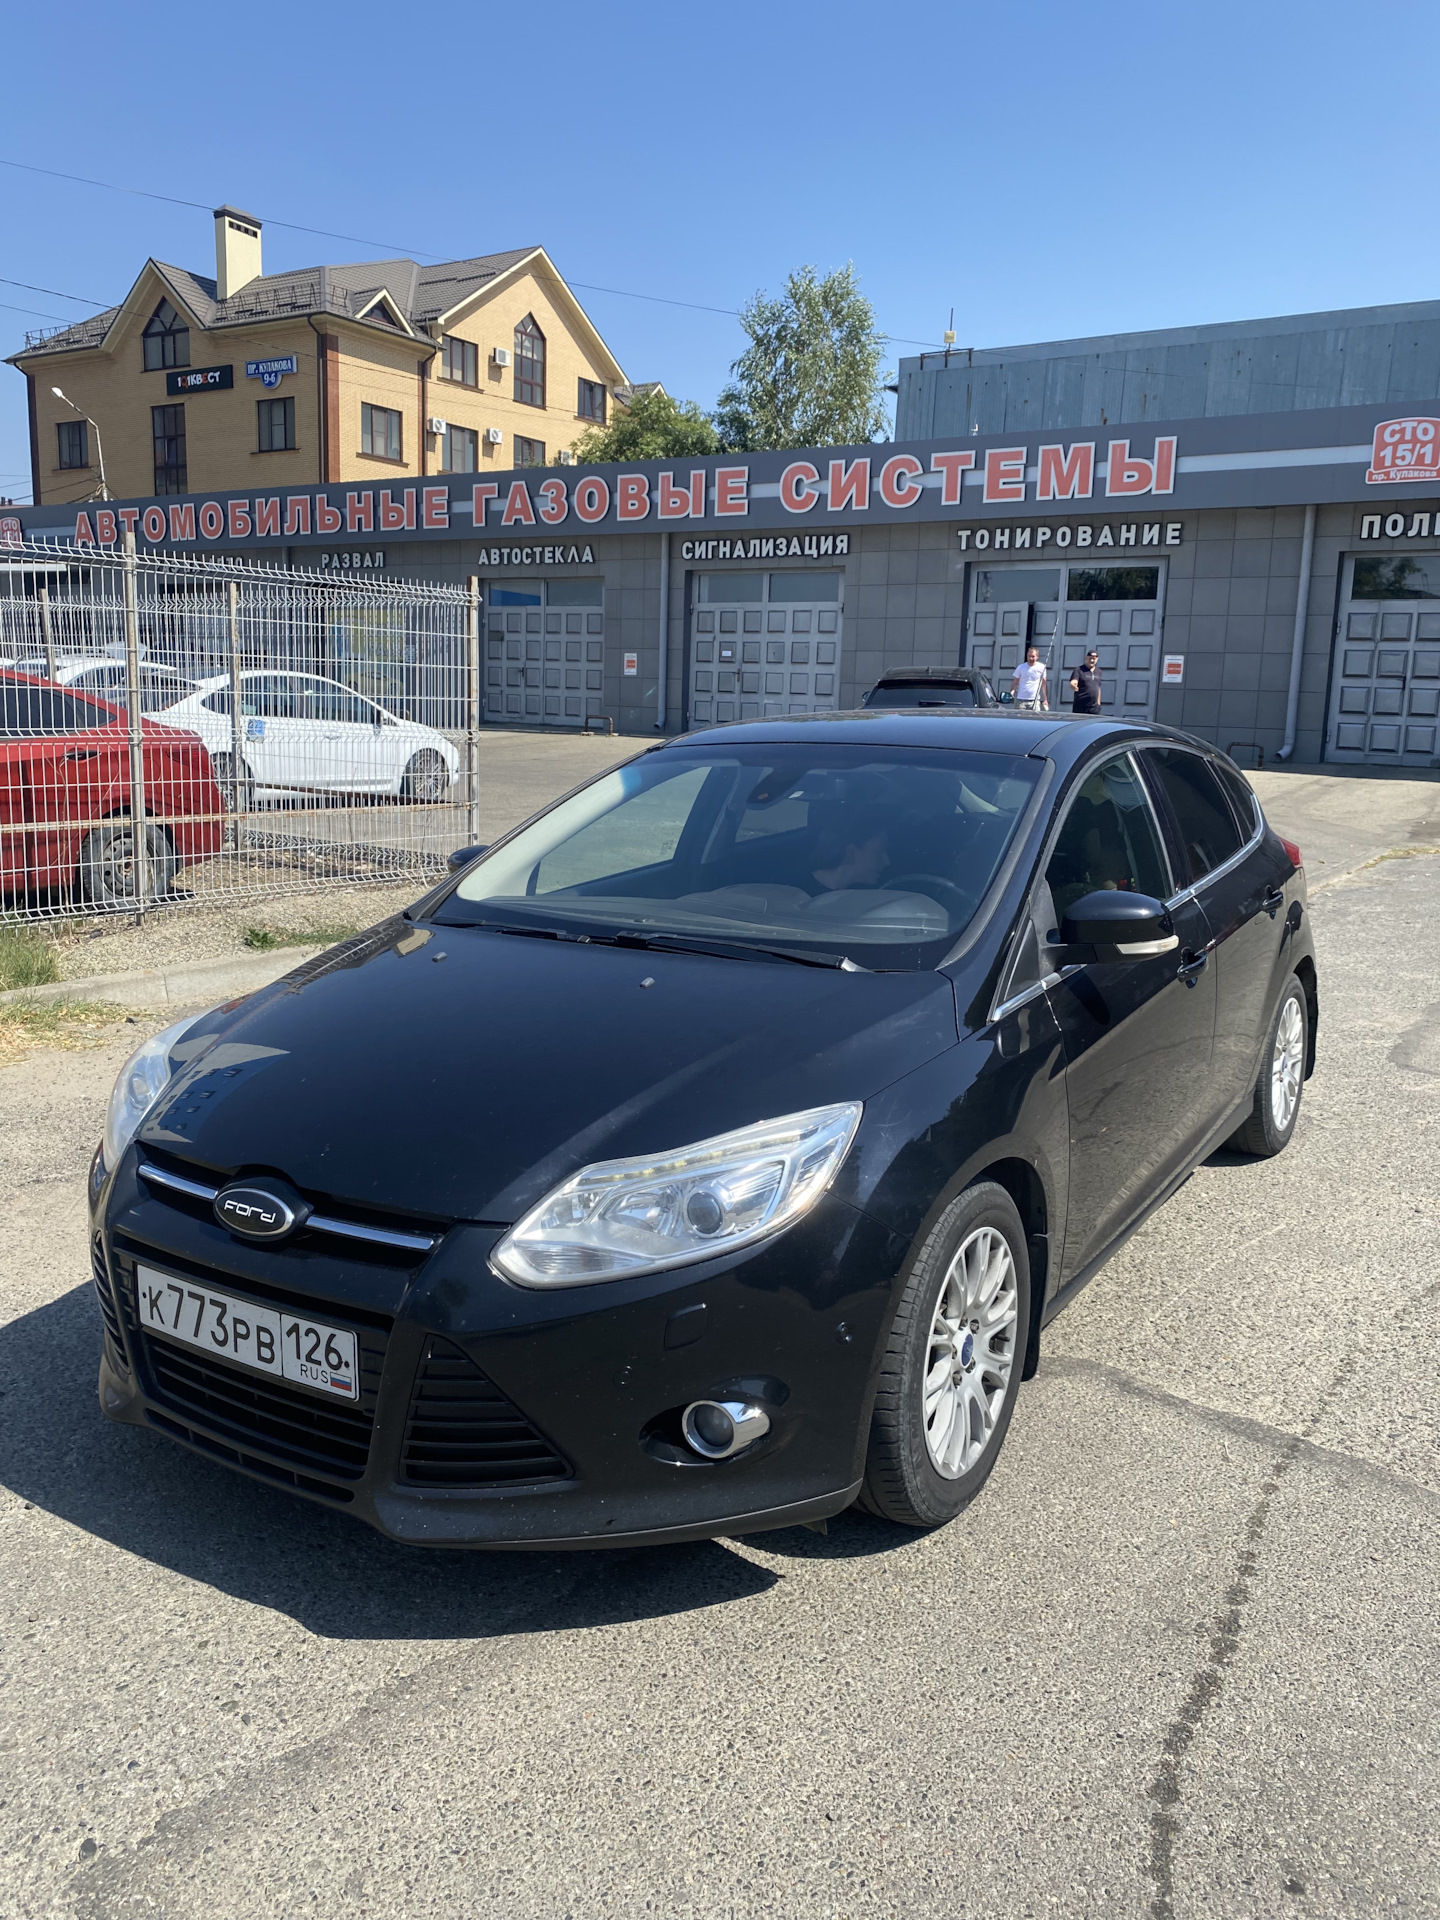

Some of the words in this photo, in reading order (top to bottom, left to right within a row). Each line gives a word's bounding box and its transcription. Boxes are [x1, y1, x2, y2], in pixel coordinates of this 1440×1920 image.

[248, 364, 258, 375] ПР.
[259, 359, 292, 374] КУЛАКОВА
[1383, 421, 1436, 443] СТО
[1379, 443, 1433, 467] 15/1
[1372, 473, 1387, 482] пр.
[1389, 469, 1437, 481] Кулакова
[73, 486, 449, 546] АВТОМОБИЛЬНЫЕ
[472, 465, 750, 528] ГАЗОВЫЕ
[779, 436, 1178, 514] СИСТЕМЫ
[2, 519, 18, 531] СТО
[681, 534, 849, 560] СИГНАЛИЗАЦИЯ
[957, 522, 1182, 551] ТОНИРОВАНИЕ
[321, 551, 385, 569] РАЗВАЛ
[478, 544, 594, 565] АВТОСТЕКЛА
[147, 1282, 276, 1365] К773РВ
[285, 1322, 344, 1371] 126
[300, 1364, 329, 1385] RUS
